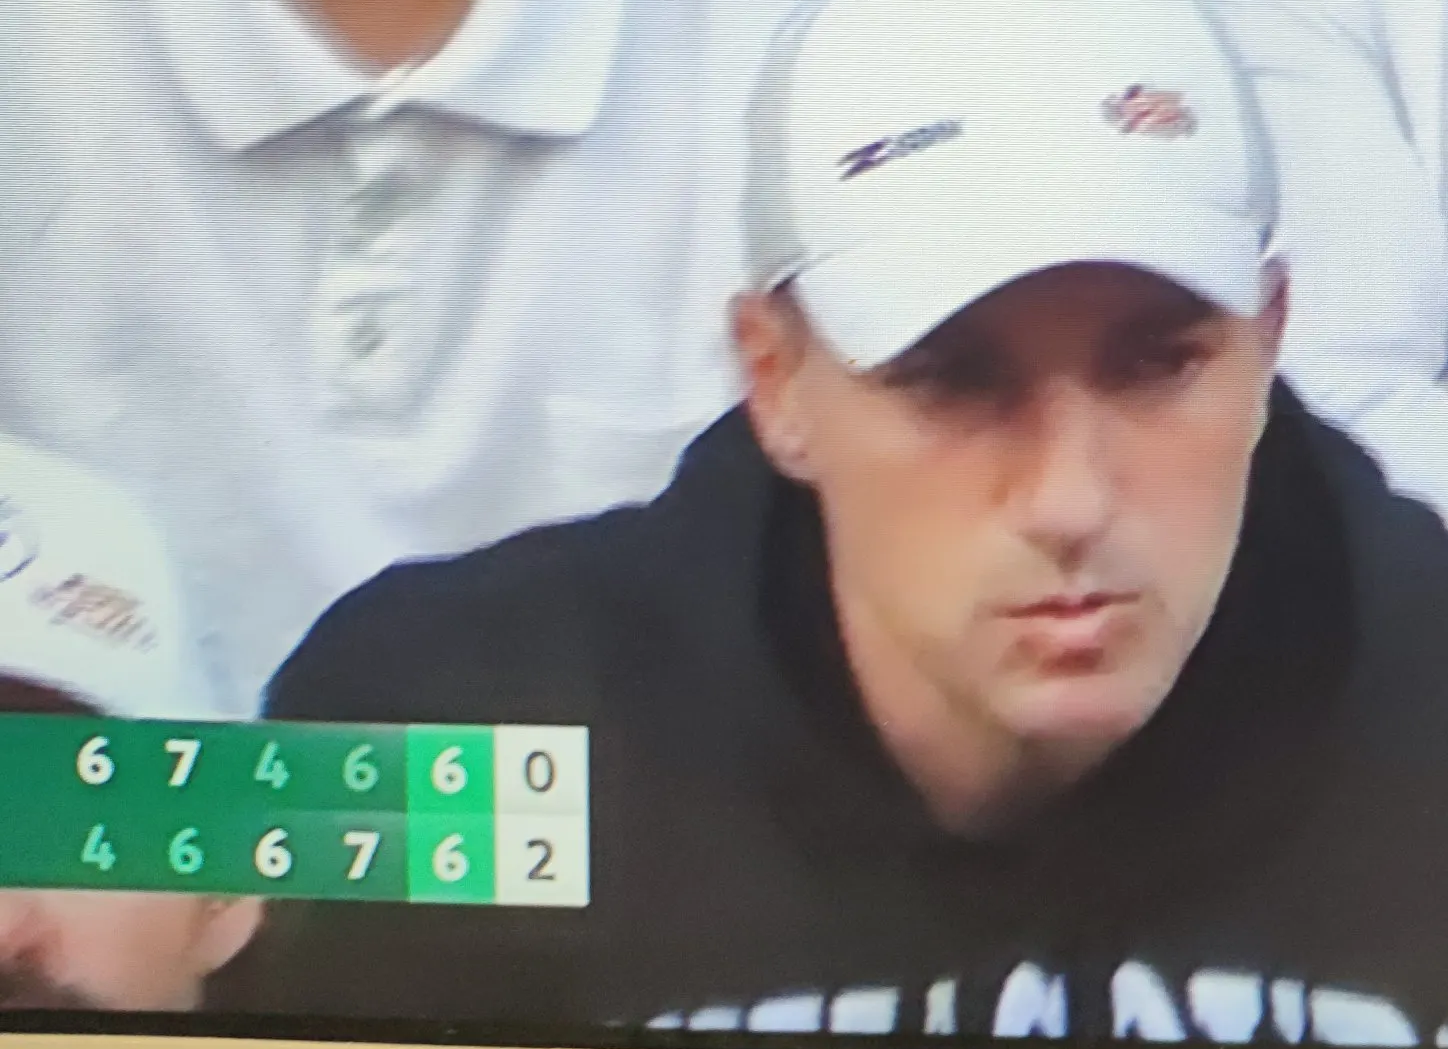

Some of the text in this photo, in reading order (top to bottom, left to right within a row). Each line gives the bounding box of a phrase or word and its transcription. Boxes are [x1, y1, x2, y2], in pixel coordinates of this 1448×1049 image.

[77, 737, 557, 794] 6 7 4 6 6 0
[81, 824, 556, 883] 4 6 6 7 6 2
